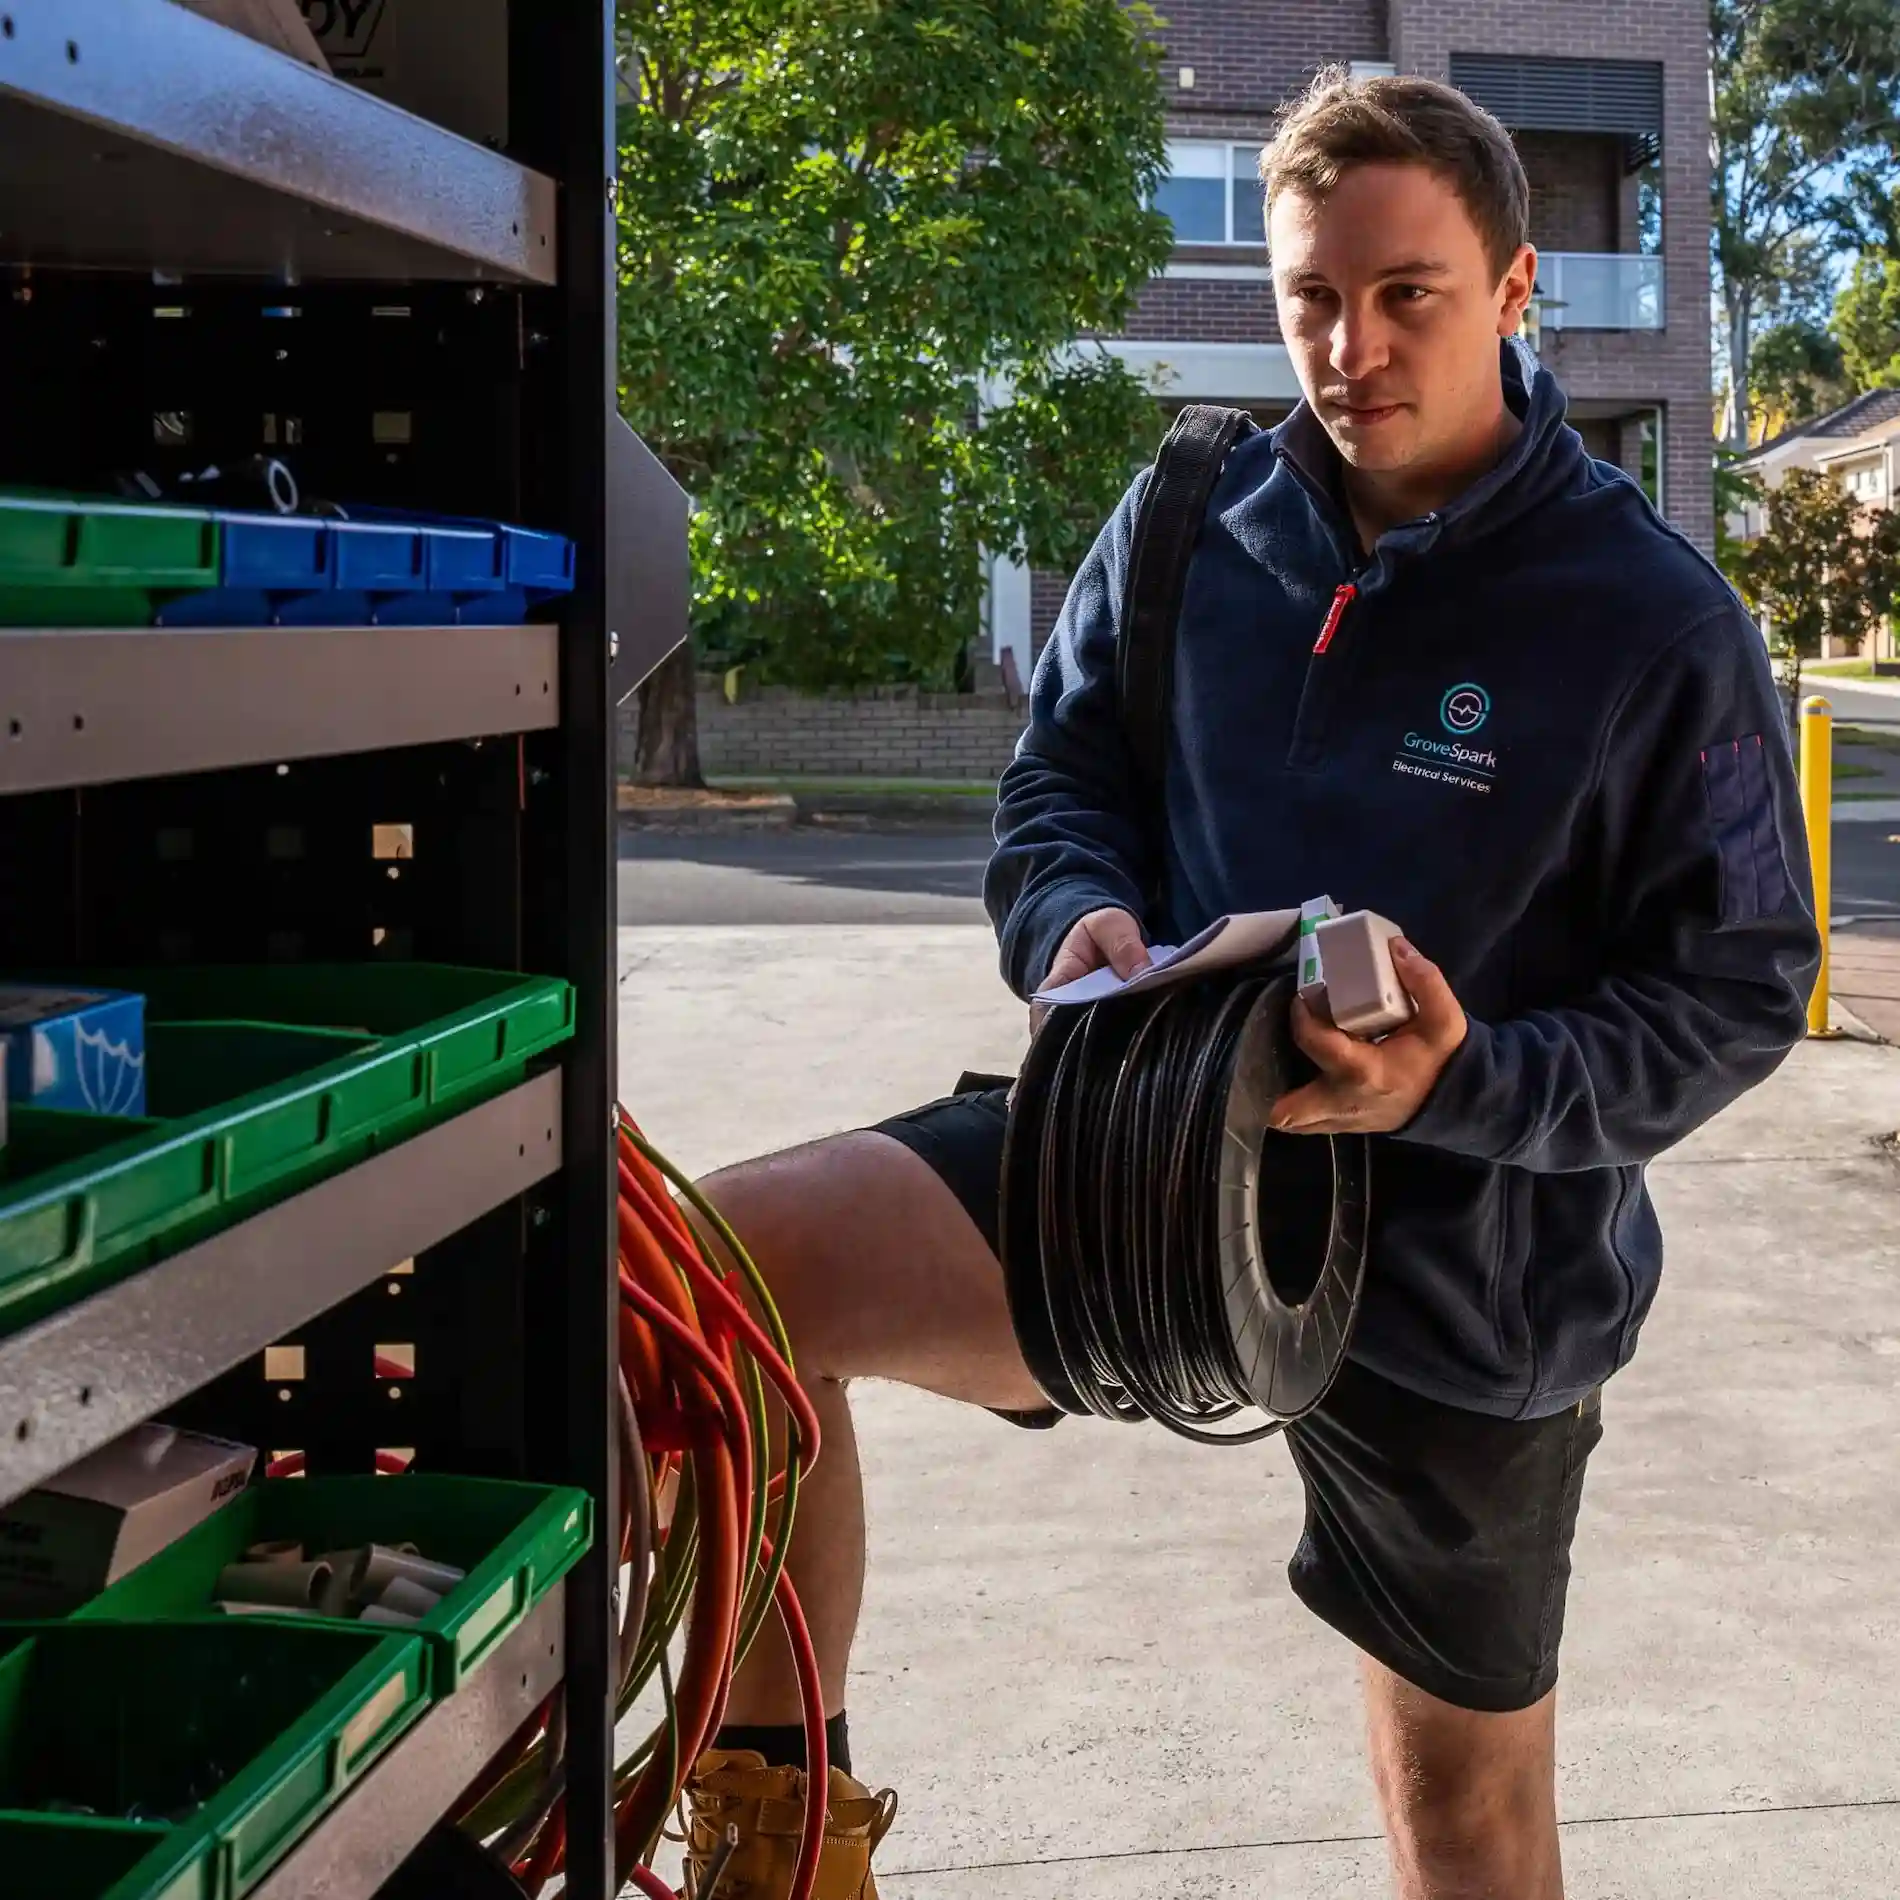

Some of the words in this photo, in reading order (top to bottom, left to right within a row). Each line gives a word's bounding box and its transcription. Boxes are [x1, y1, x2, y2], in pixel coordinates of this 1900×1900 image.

[1403, 732, 1497, 768] GroveSpark
[1392, 760, 1440, 780] Electrical
[1441, 772, 1491, 793] Services
